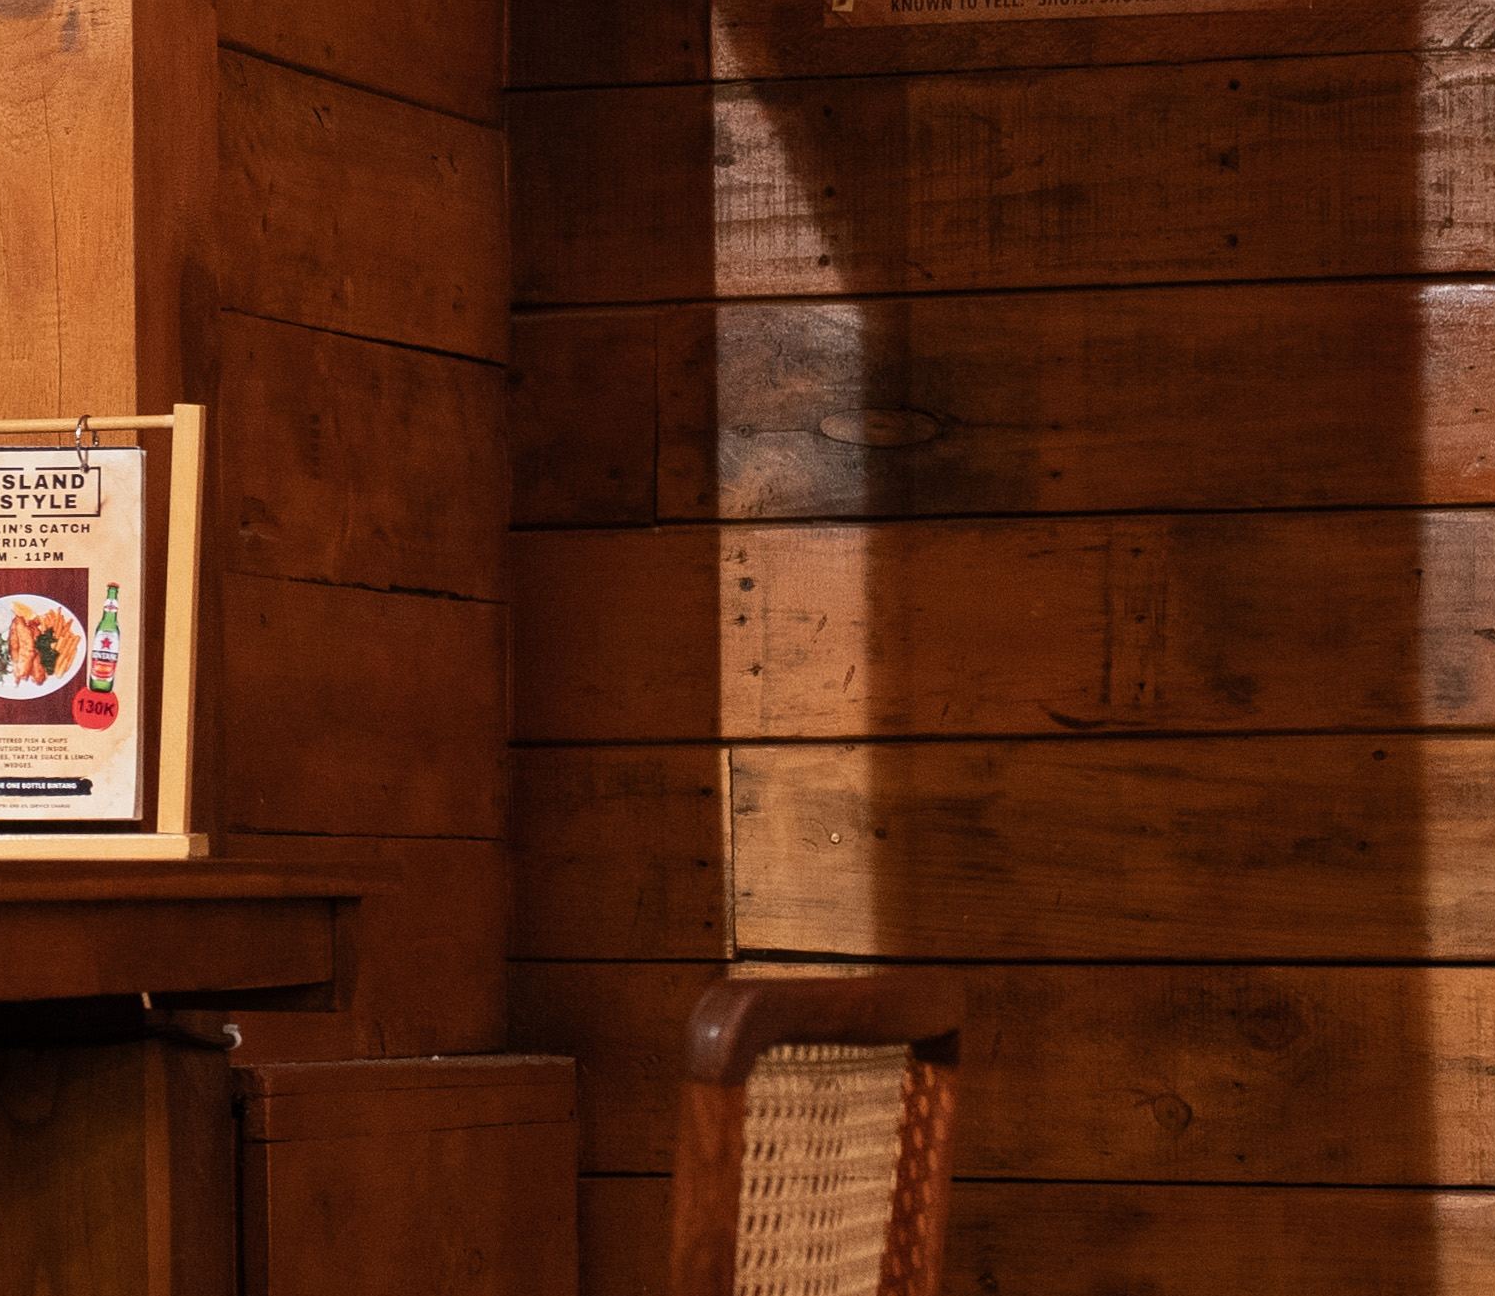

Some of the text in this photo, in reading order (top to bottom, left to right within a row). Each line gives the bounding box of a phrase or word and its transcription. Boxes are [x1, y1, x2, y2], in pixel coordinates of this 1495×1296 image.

[1, 494, 76, 509] STYLE
[40, 524, 90, 533] CATCH
[26, 552, 63, 561] 11PM
[78, 699, 115, 716] 130K
